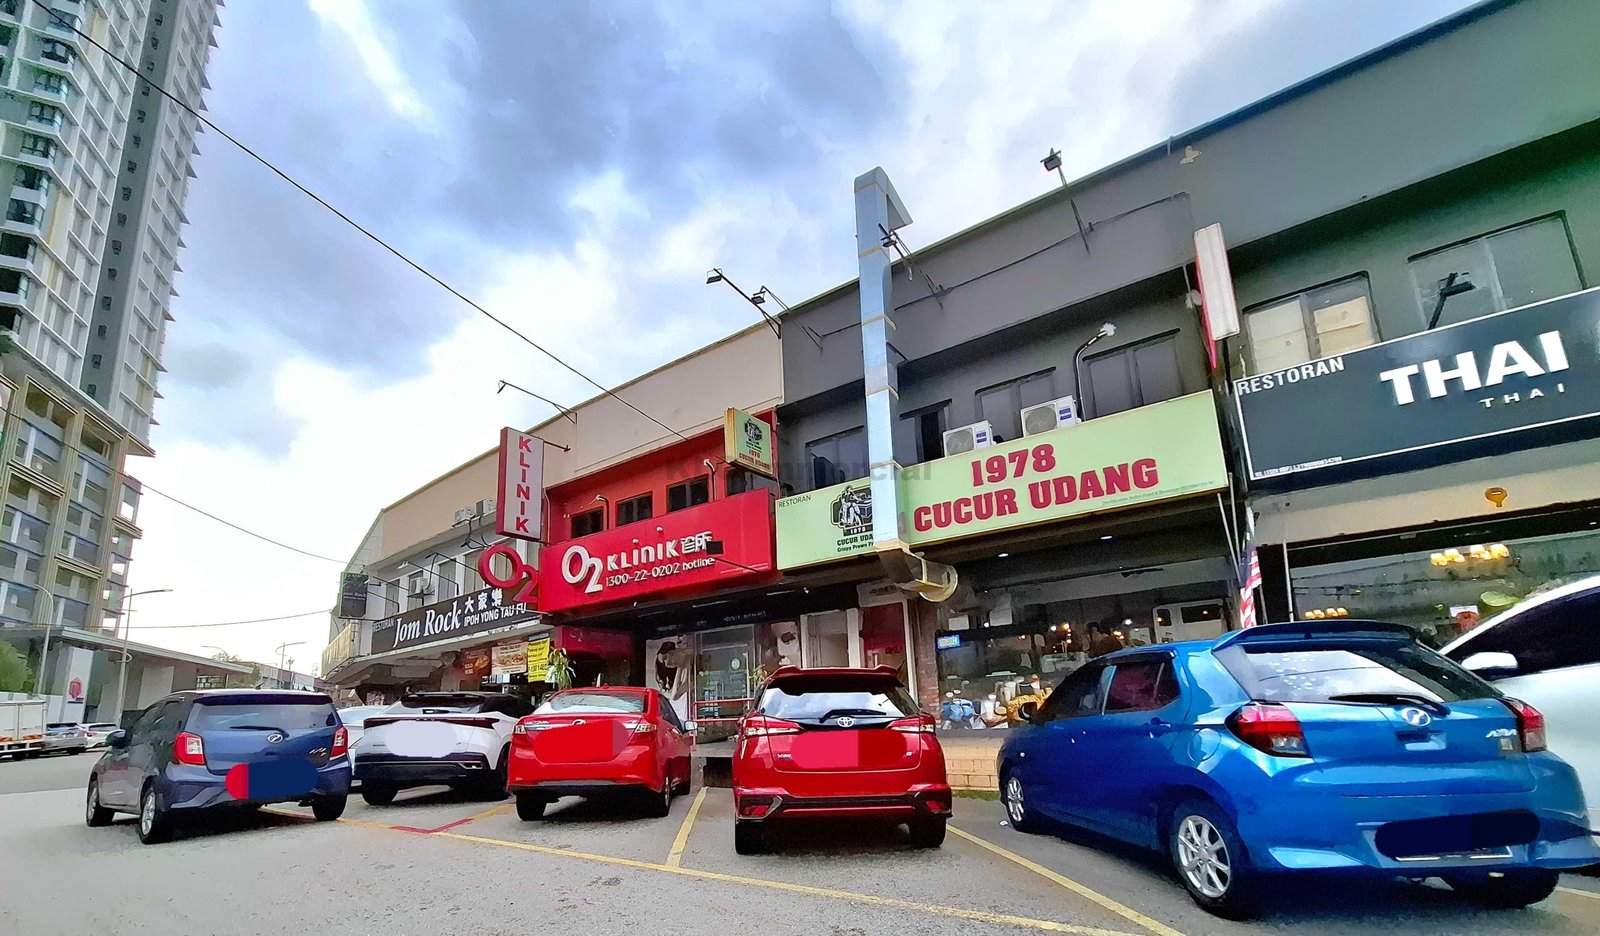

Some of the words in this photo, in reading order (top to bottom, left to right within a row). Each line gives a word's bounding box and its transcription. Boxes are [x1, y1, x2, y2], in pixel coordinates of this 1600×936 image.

[1237, 357, 1345, 396] RESTORAN
[1380, 330, 1570, 406] THAI
[1481, 383, 1566, 408] THAI
[971, 443, 1056, 487] 1978
[515, 436, 532, 534] KLINIK
[778, 494, 812, 508] RESTORAN
[914, 487, 1018, 532] CUCUR
[1028, 457, 1159, 509] UDANG
[837, 537, 858, 546] CUCUR
[606, 563, 680, 587] 1300-22-0202
[682, 557, 716, 571] hotline
[393, 618, 420, 648] Jom
[423, 600, 462, 637] Rock
[464, 614, 479, 626] IPOH
[481, 609, 499, 621] YONG
[501, 604, 514, 618] TAU
